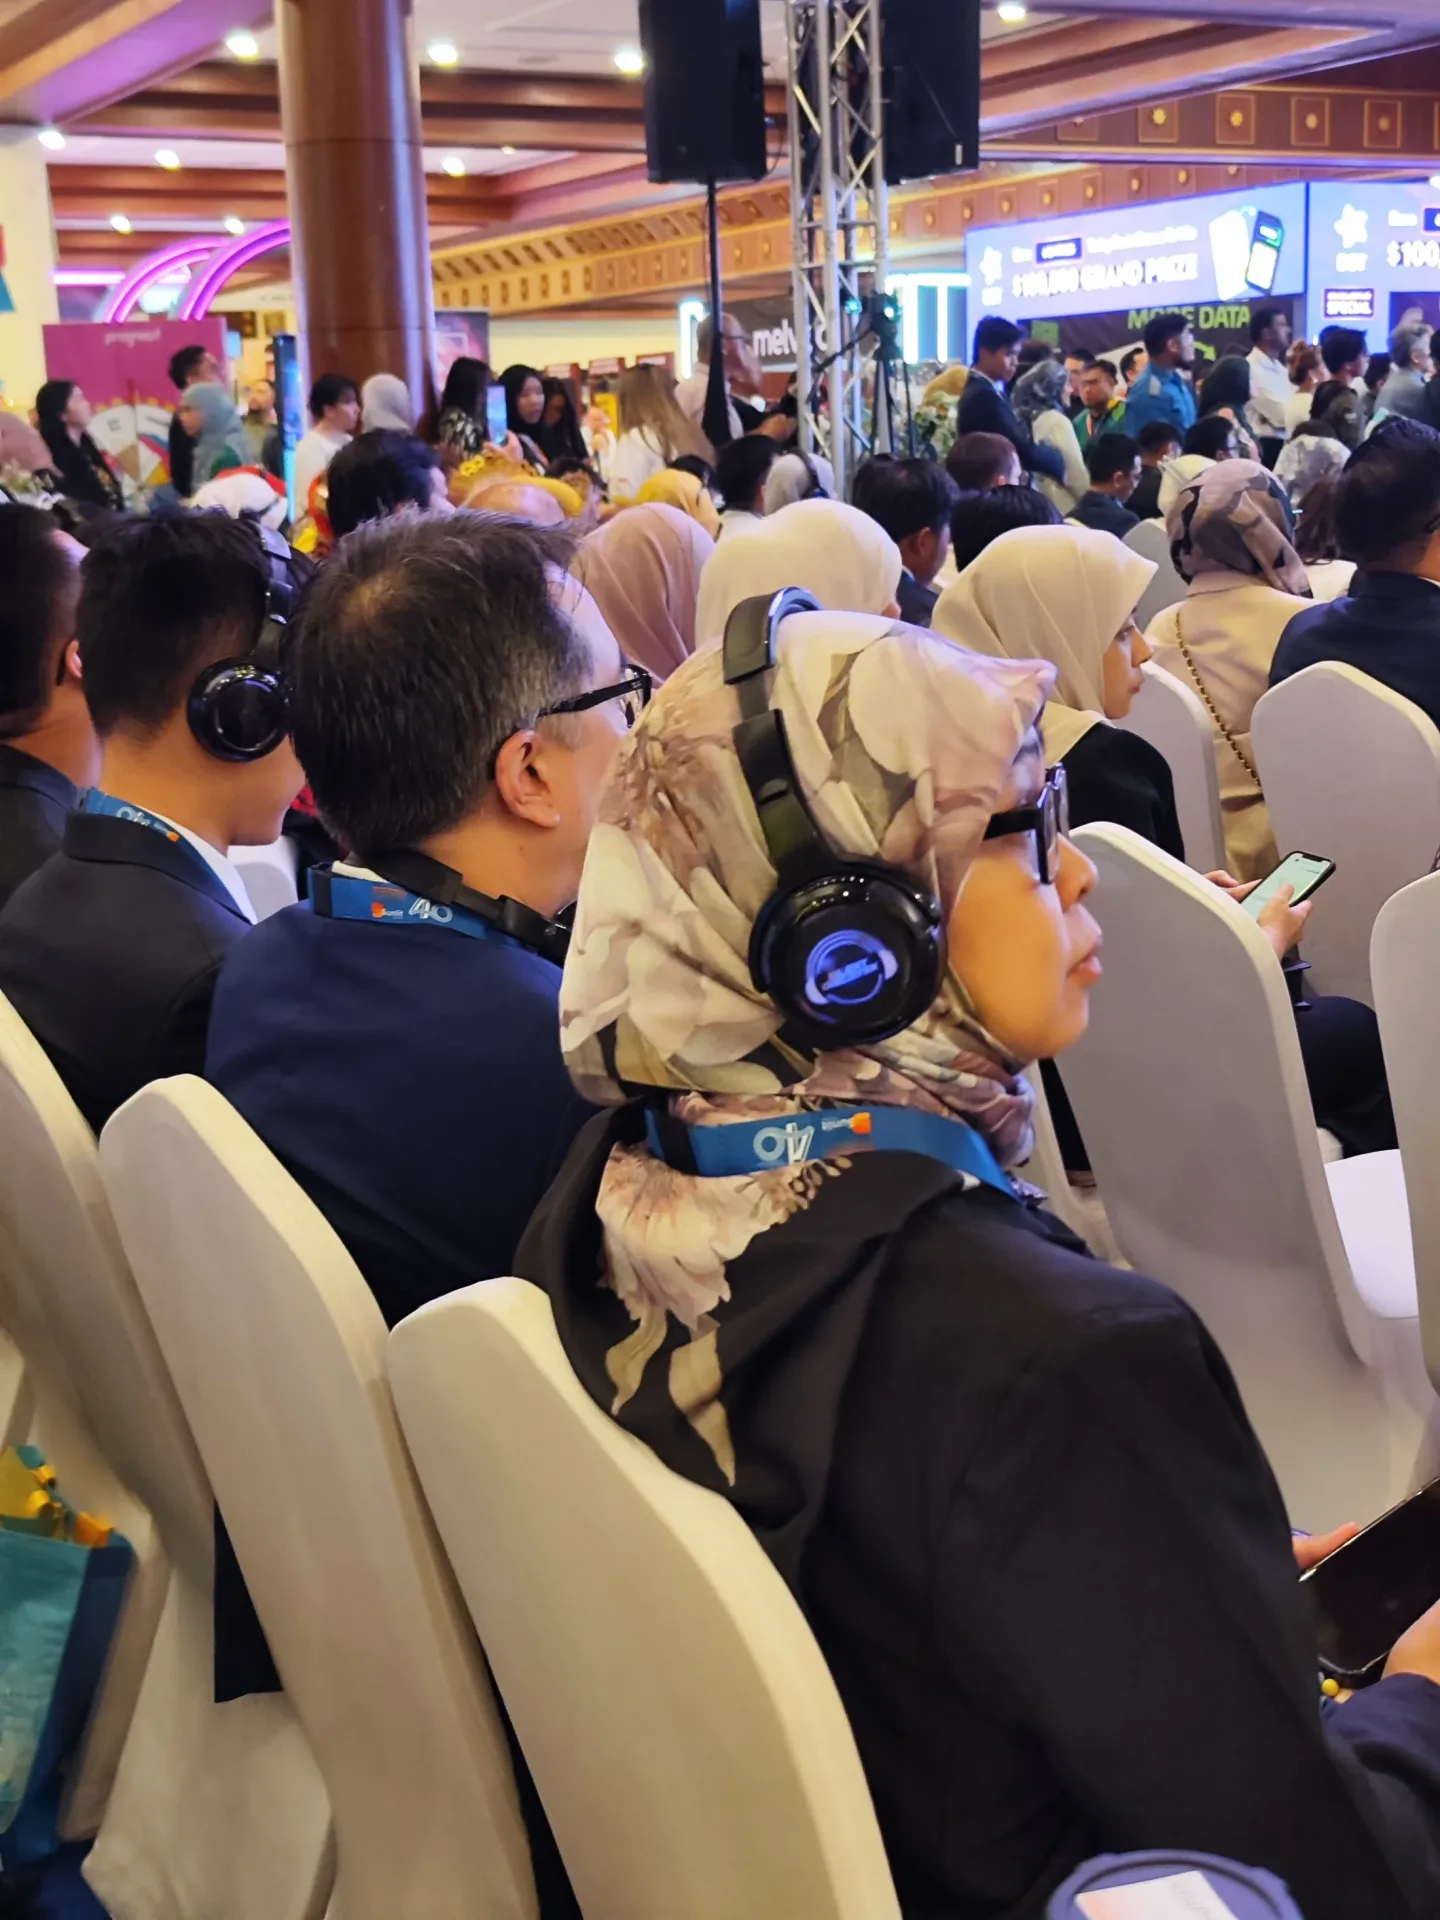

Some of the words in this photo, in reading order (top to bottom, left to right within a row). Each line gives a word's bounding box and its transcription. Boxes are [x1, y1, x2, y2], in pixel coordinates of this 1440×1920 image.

[1080, 259, 1143, 291] GRAND
[1145, 253, 1199, 285] PRIZE
[1199, 305, 1250, 329] DATA
